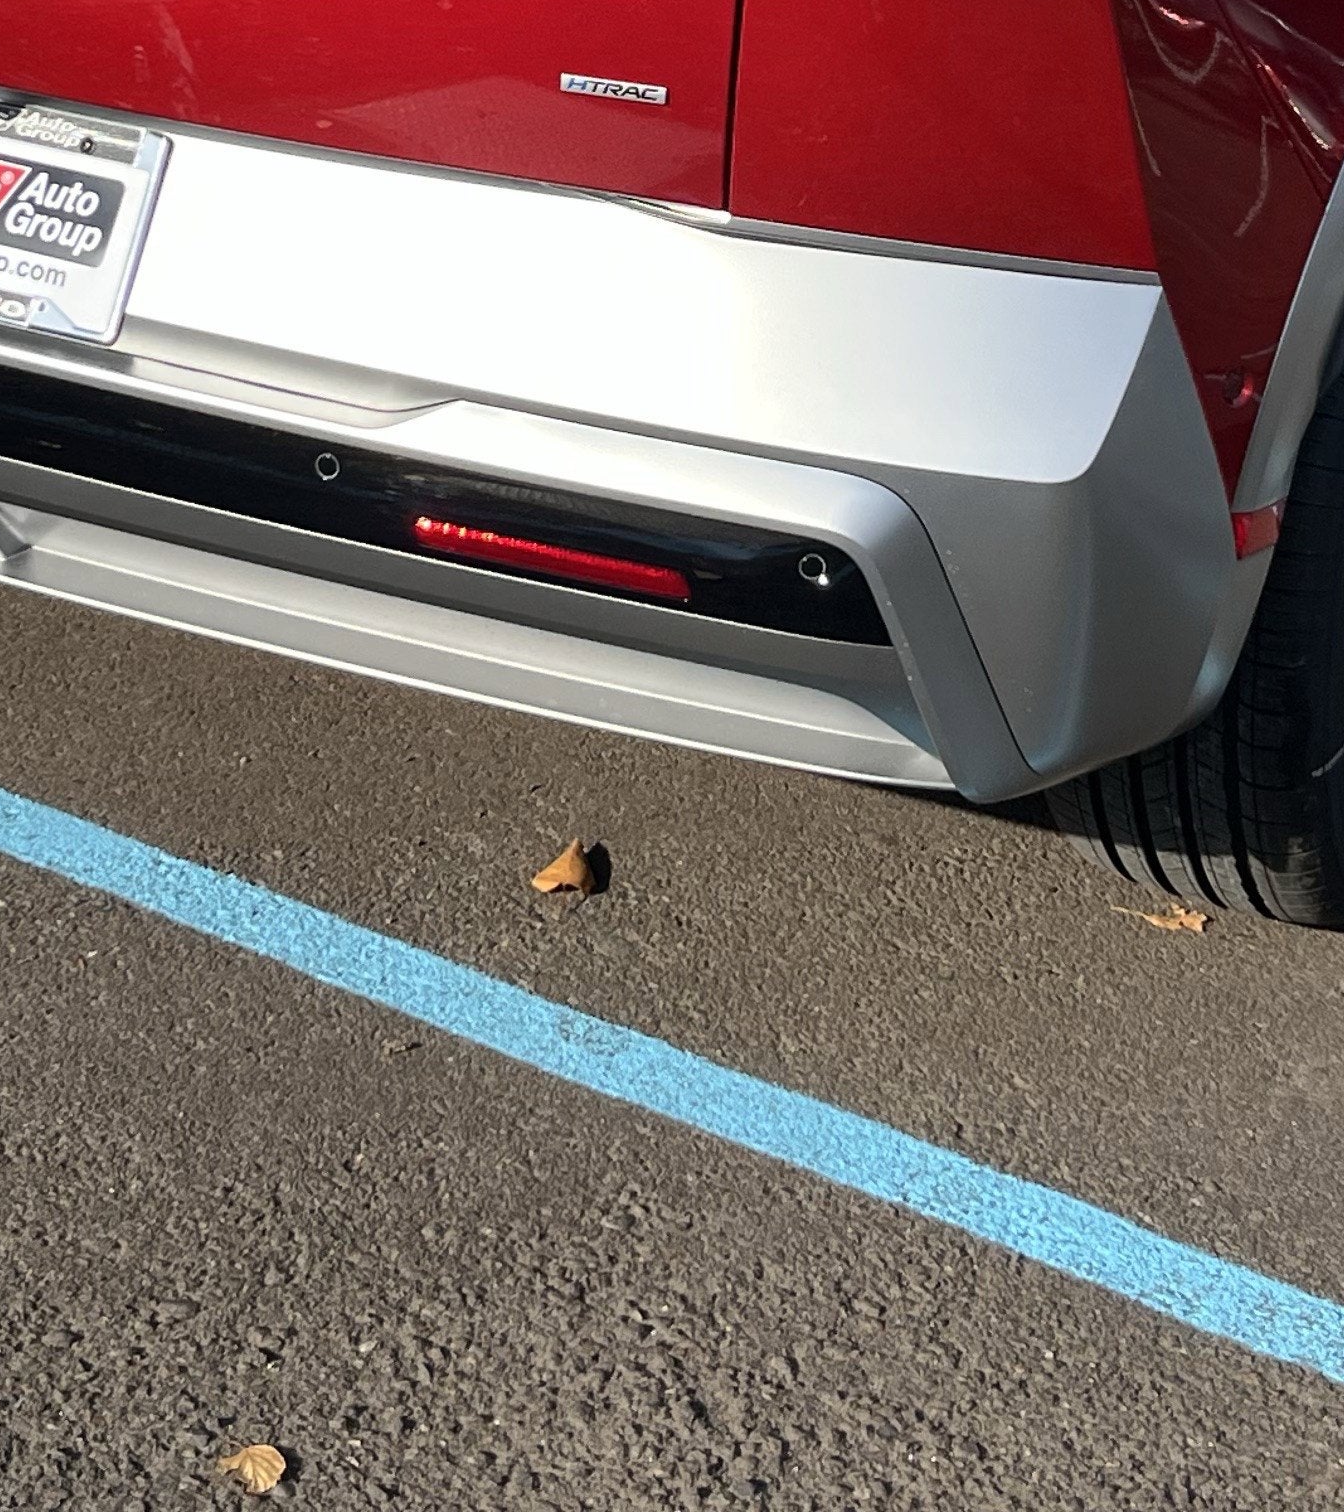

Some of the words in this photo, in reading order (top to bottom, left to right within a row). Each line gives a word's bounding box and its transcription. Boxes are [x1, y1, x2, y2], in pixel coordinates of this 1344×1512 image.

[567, 78, 658, 101] HTRAC
[23, 110, 75, 132] Auto
[15, 123, 80, 149] Group
[18, 172, 99, 217] Auto
[5, 202, 103, 257] Group
